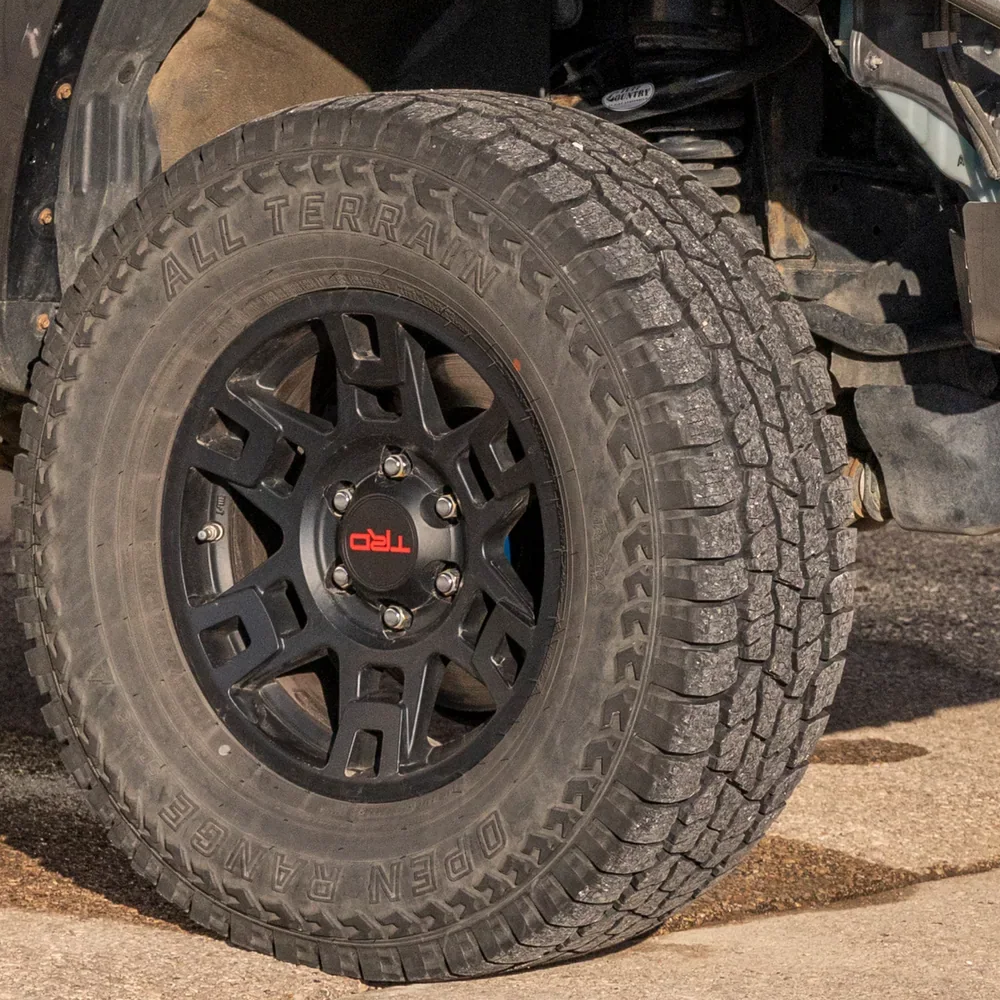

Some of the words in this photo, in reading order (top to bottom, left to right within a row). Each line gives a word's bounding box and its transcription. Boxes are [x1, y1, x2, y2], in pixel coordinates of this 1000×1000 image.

[160, 215, 247, 301] ALL
[264, 192, 501, 296] TERRAIN
[349, 528, 411, 554] TRD
[158, 794, 343, 903] RANGE
[368, 810, 509, 904] OPEN
